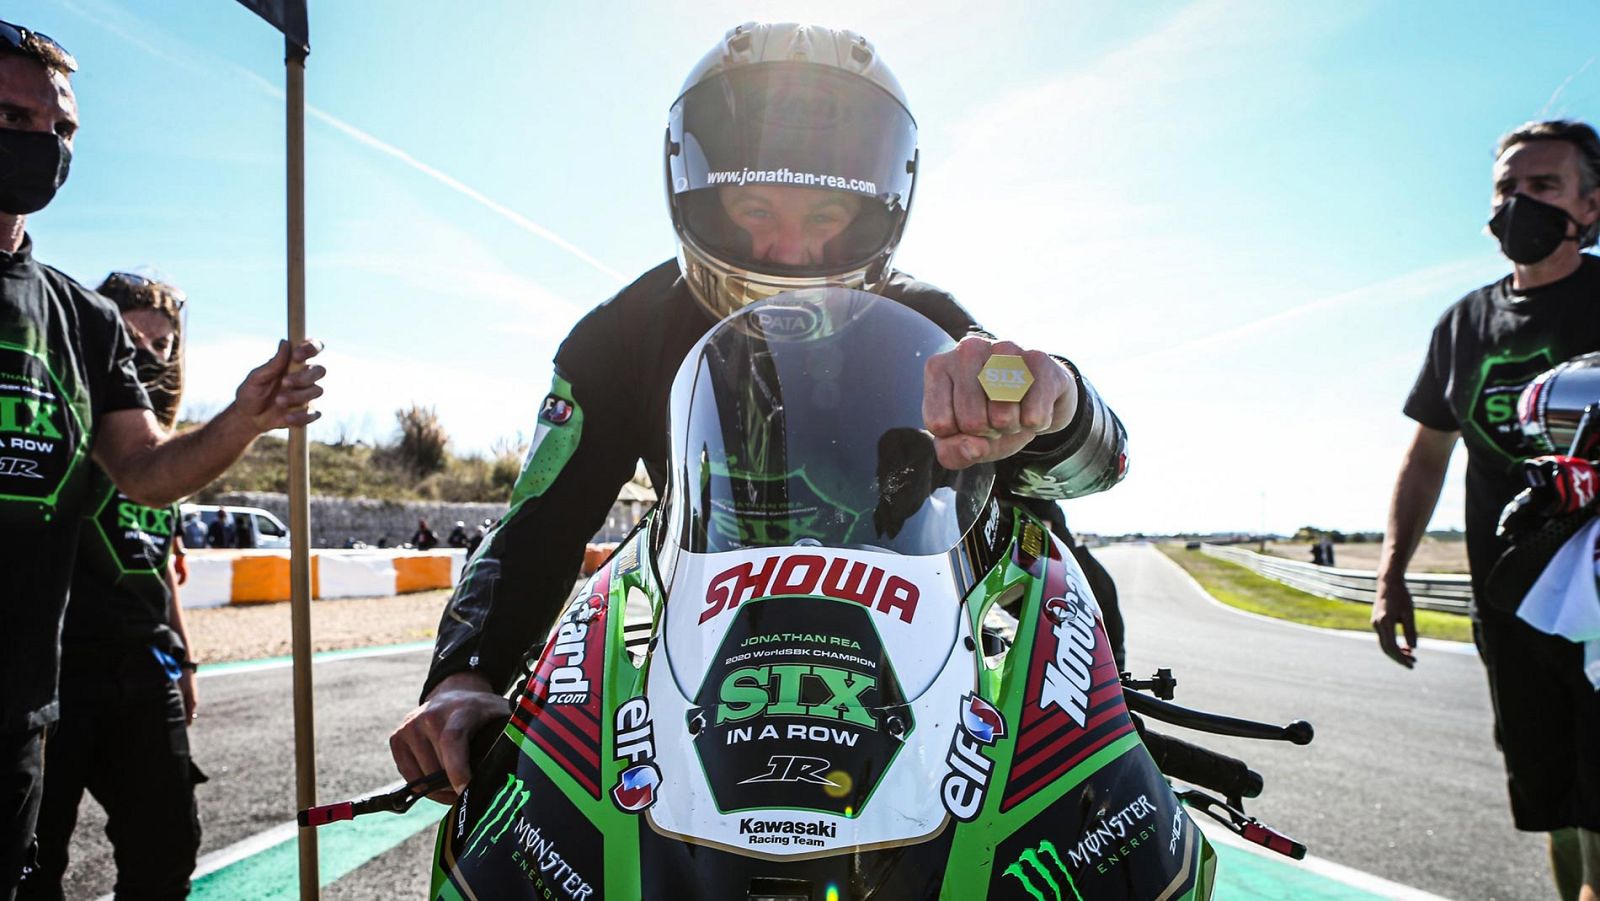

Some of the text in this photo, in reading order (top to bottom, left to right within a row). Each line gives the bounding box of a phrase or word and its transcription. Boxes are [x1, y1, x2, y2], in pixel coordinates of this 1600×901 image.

[706, 167, 877, 194] www.jonathan-rea.com
[758, 314, 806, 332] PATA
[11, 438, 54, 453] ROW
[118, 501, 171, 537] SIX
[698, 554, 920, 625] SHOWA
[740, 633, 861, 650] JONATHAN REA
[725, 648, 876, 669] 2020 WorldSBK CHAMPION
[714, 663, 878, 731] SIX
[616, 699, 653, 762] elf
[727, 724, 860, 747] IN A ROW
[944, 729, 991, 819] elf
[739, 818, 837, 838] Kawasaki
[748, 835, 825, 847] Racing Team
[1096, 823, 1157, 874] ENERGY
[511, 850, 558, 901] ENERG
